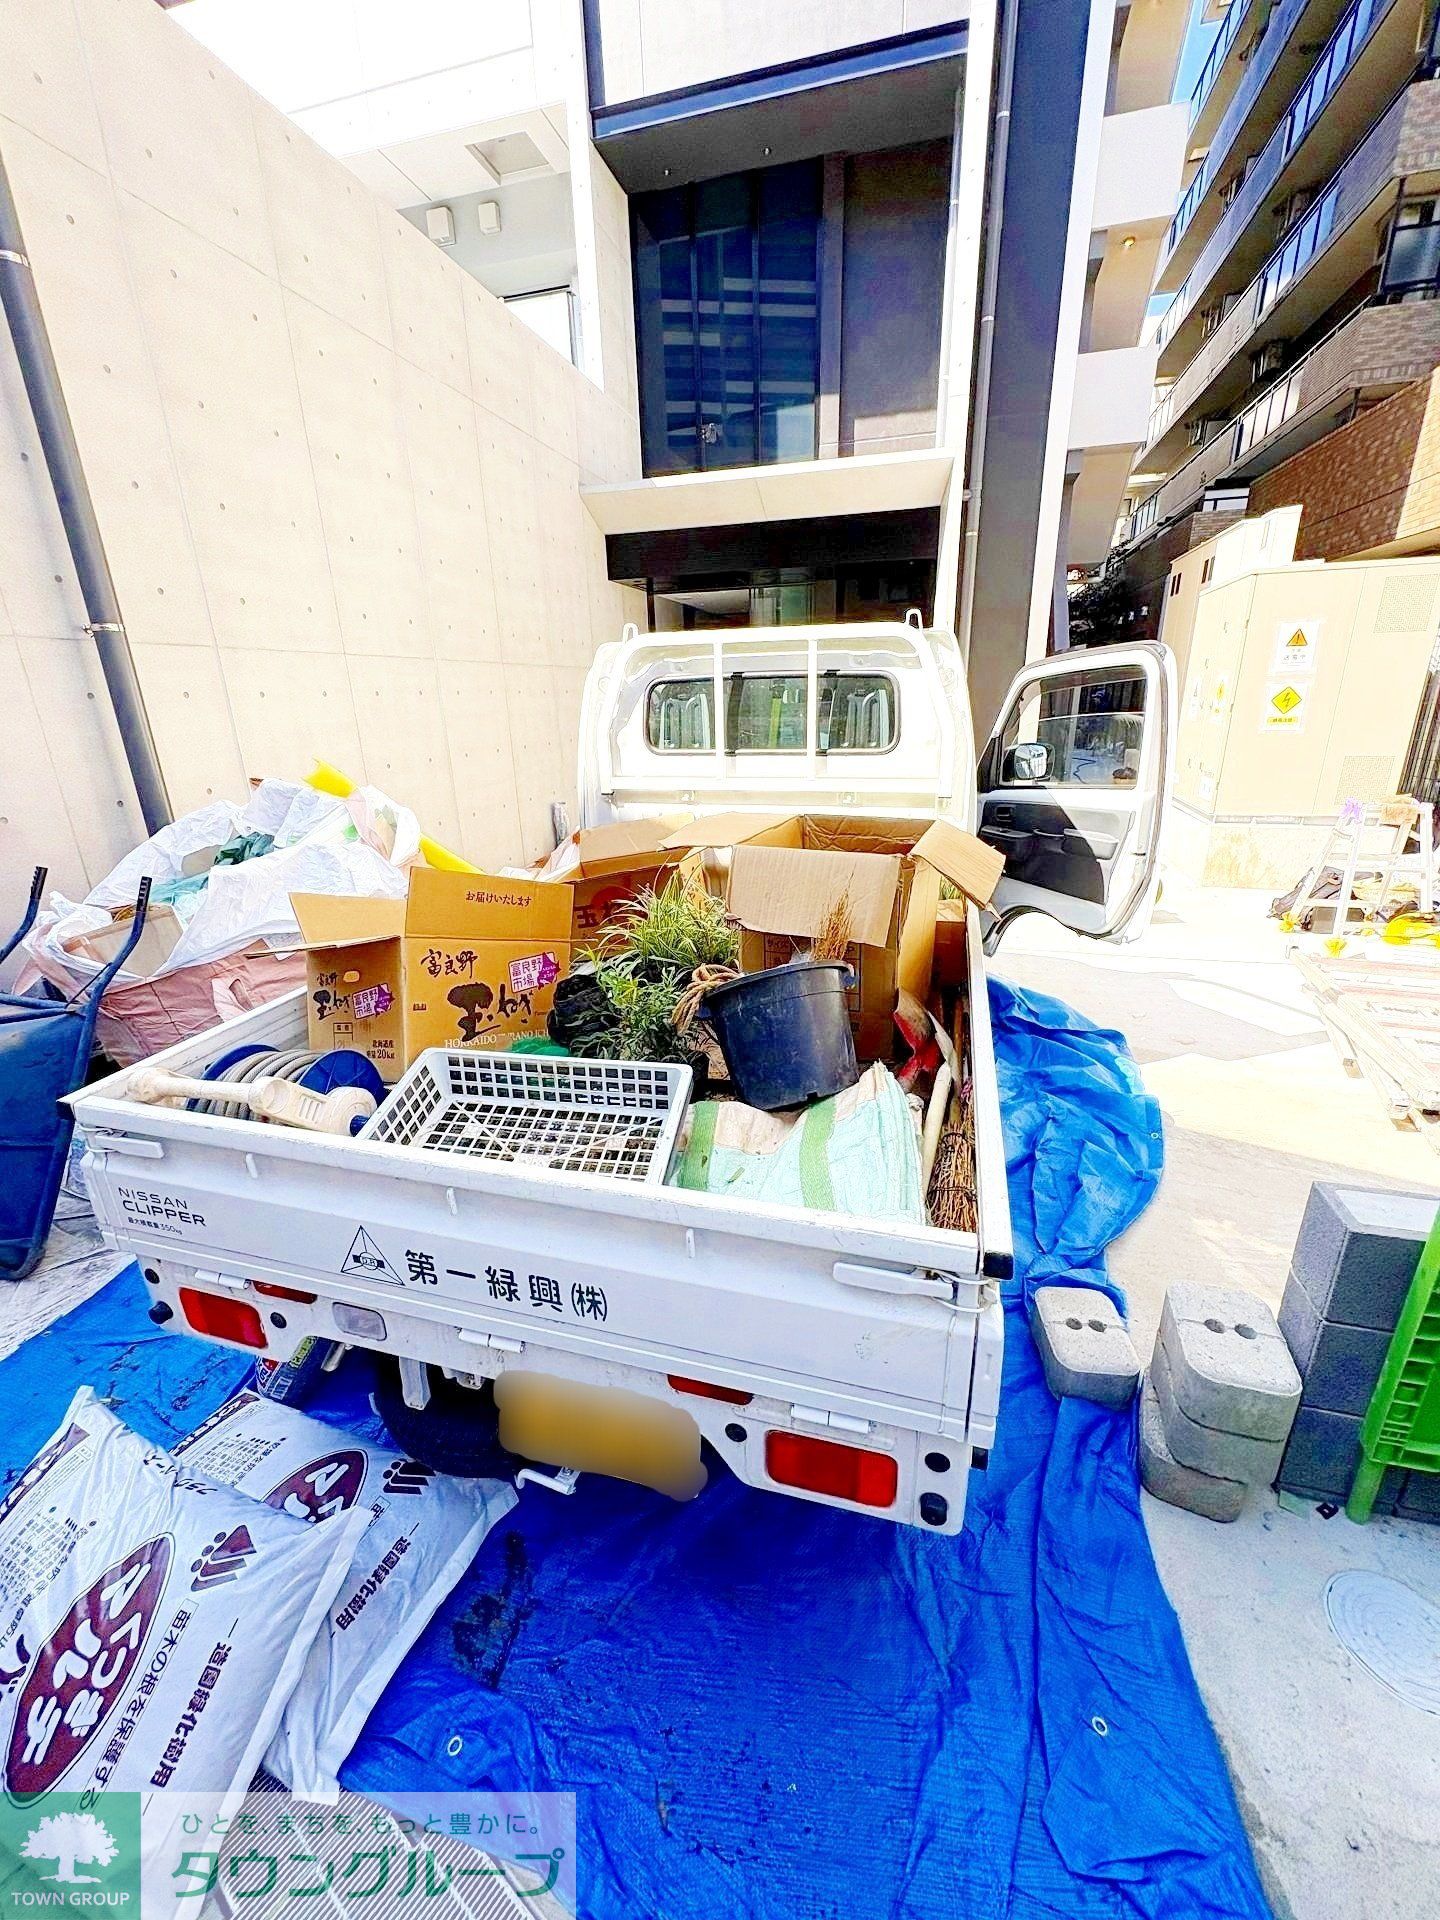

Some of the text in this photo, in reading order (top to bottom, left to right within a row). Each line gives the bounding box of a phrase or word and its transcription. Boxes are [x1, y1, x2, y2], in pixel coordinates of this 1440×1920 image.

[465, 890, 532, 907] お届けいたします
[420, 948, 478, 979] 富良野
[510, 957, 543, 977] 富良野
[512, 972, 536, 990] 市場
[117, 1186, 189, 1210] NISSAN
[122, 1199, 208, 1228] CLIPPER
[335, 1533, 412, 1631] 造園緑化樹用
[21, 1561, 145, 1766] マルチ
[64, 1613, 141, 1738] くつぎ
[79, 1608, 195, 1810] 苗木の根を保護する
[149, 1639, 234, 1789] 造園緑化樹用
